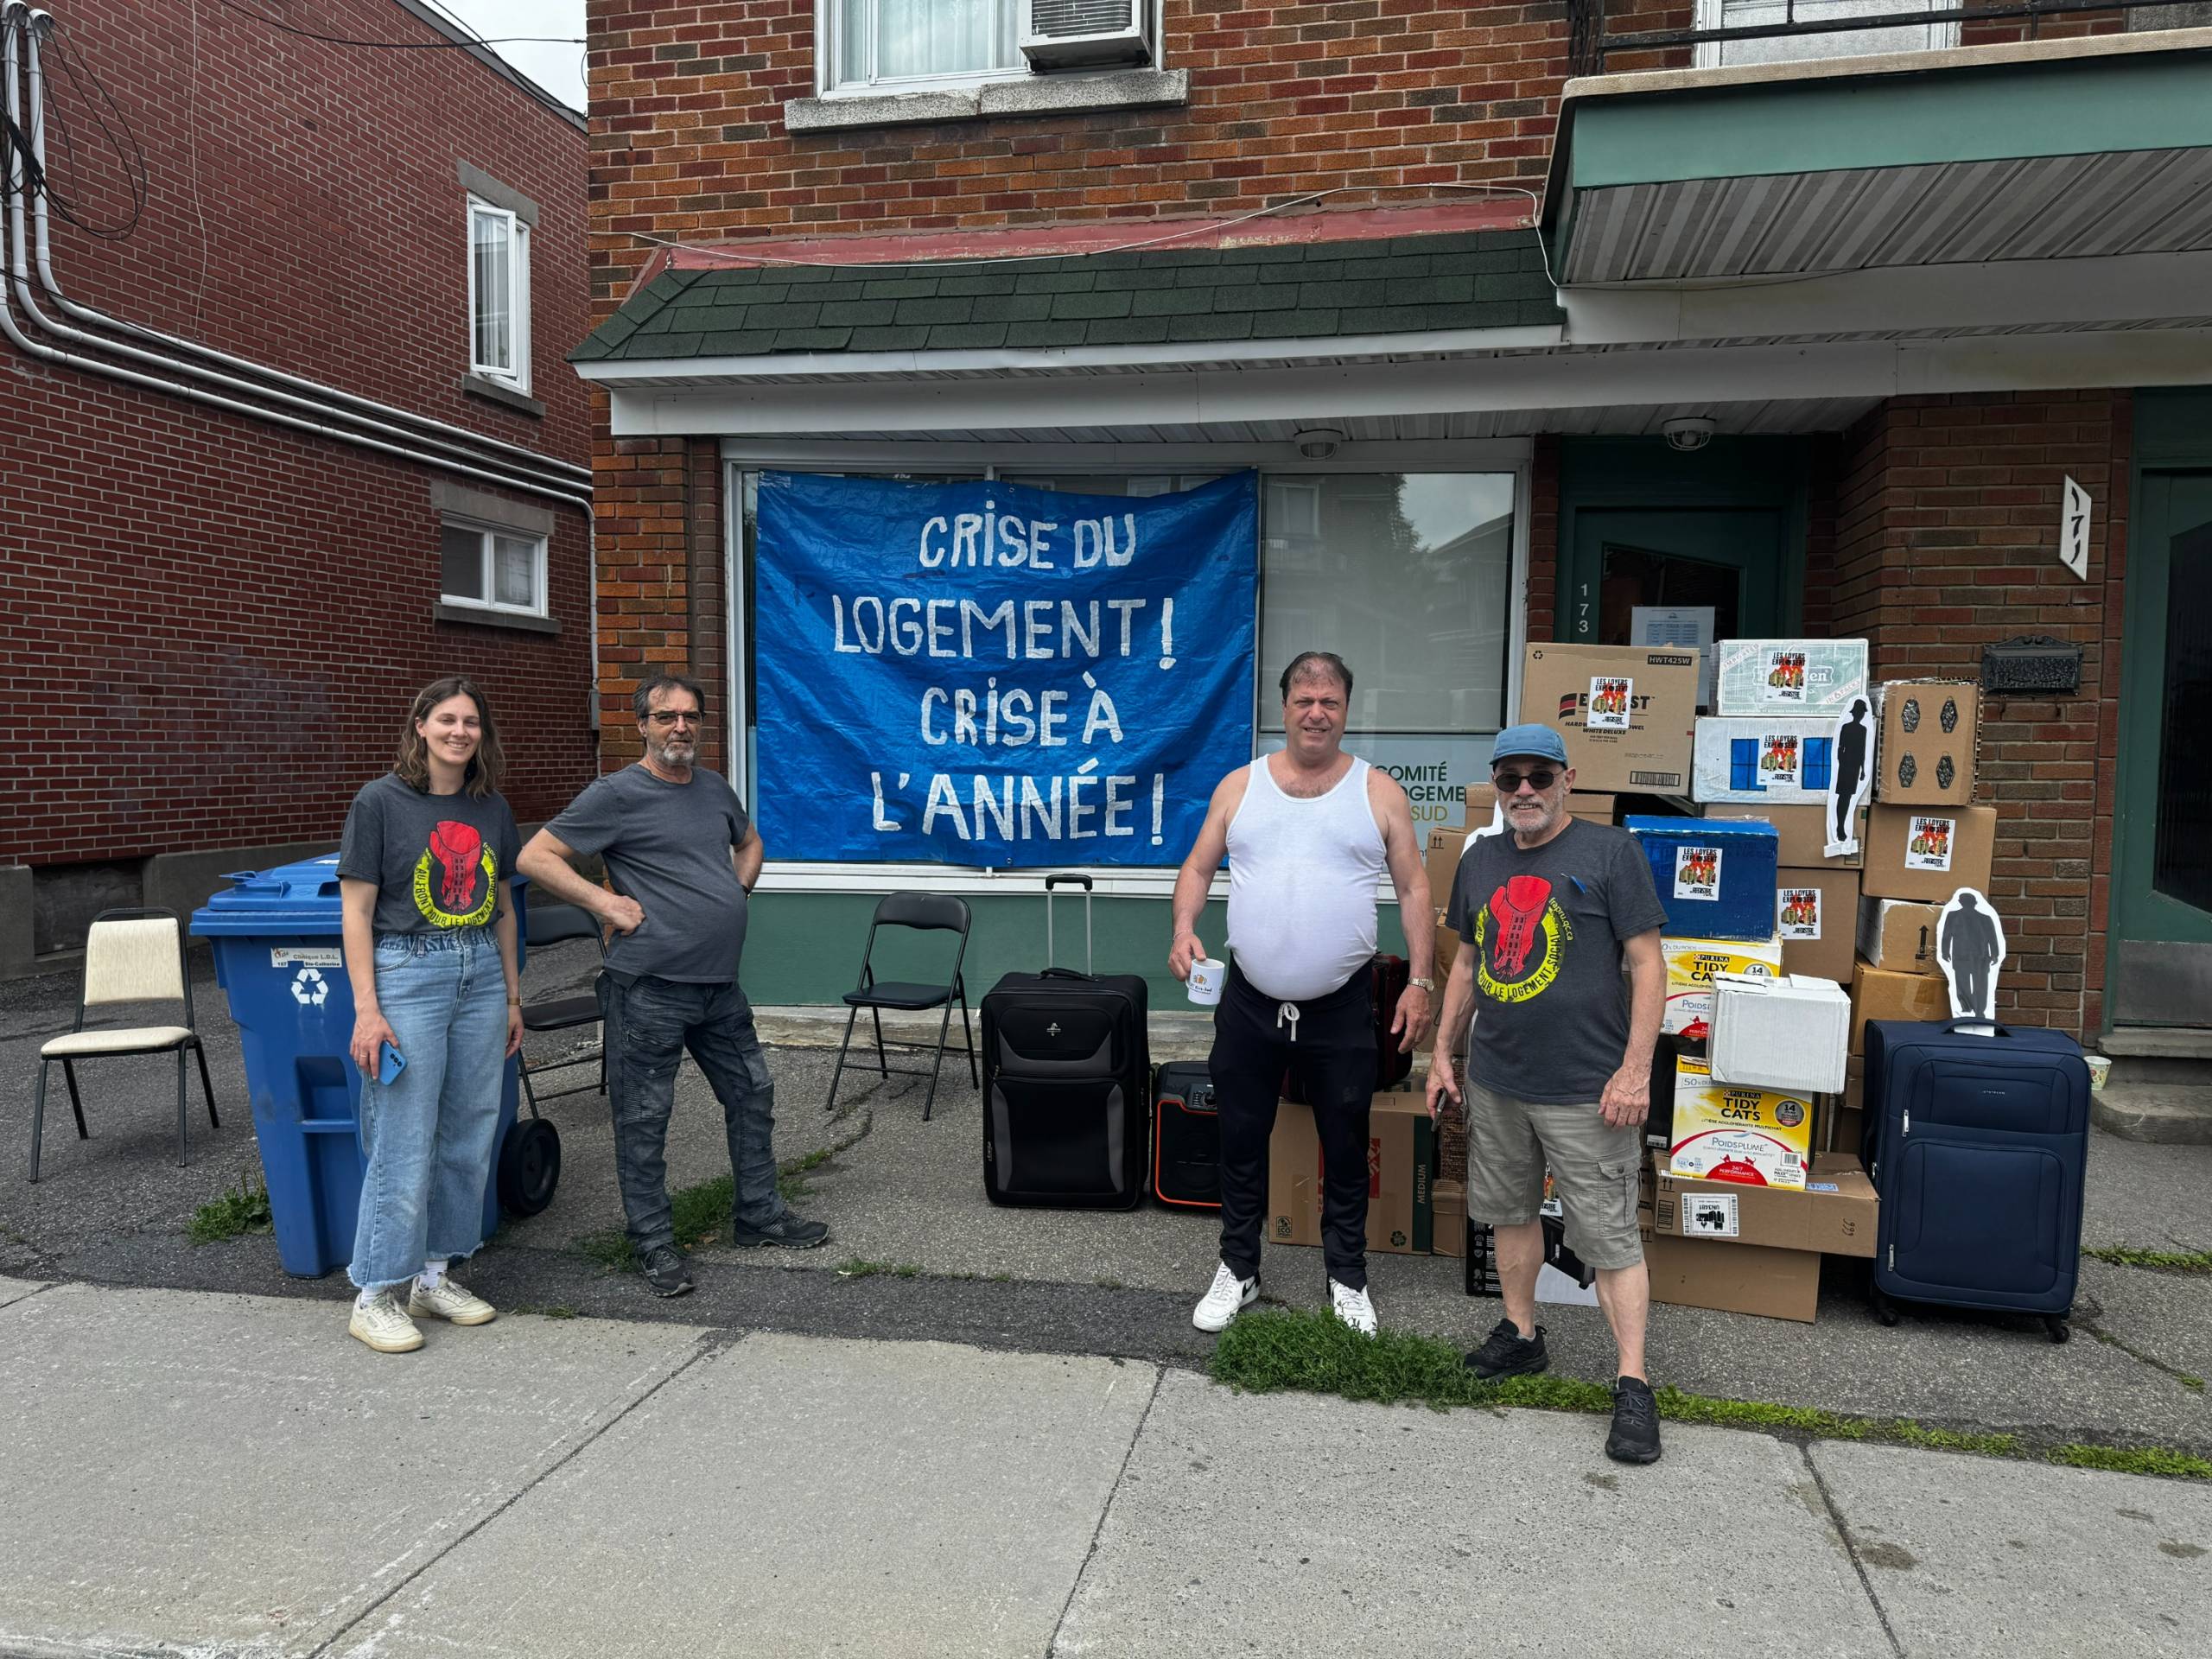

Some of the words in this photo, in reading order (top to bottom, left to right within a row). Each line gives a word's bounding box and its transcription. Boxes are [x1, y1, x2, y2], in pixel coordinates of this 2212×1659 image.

[1073, 514, 1136, 568] DU
[1649, 656, 1691, 664] HWT425W
[1082, 671, 1123, 744] À
[1548, 897, 1573, 941] frapru.qc.ca
[1494, 987, 1504, 998] LE
[1507, 967, 1552, 999] LOGEMENT
[1547, 933, 1561, 971] SOCIAL
[1694, 962, 1728, 972] TIDY
[1721, 1108, 1761, 1121] CATS
[1723, 1097, 1759, 1110] TIDY
[1417, 1164, 1426, 1204] MEDIUM
